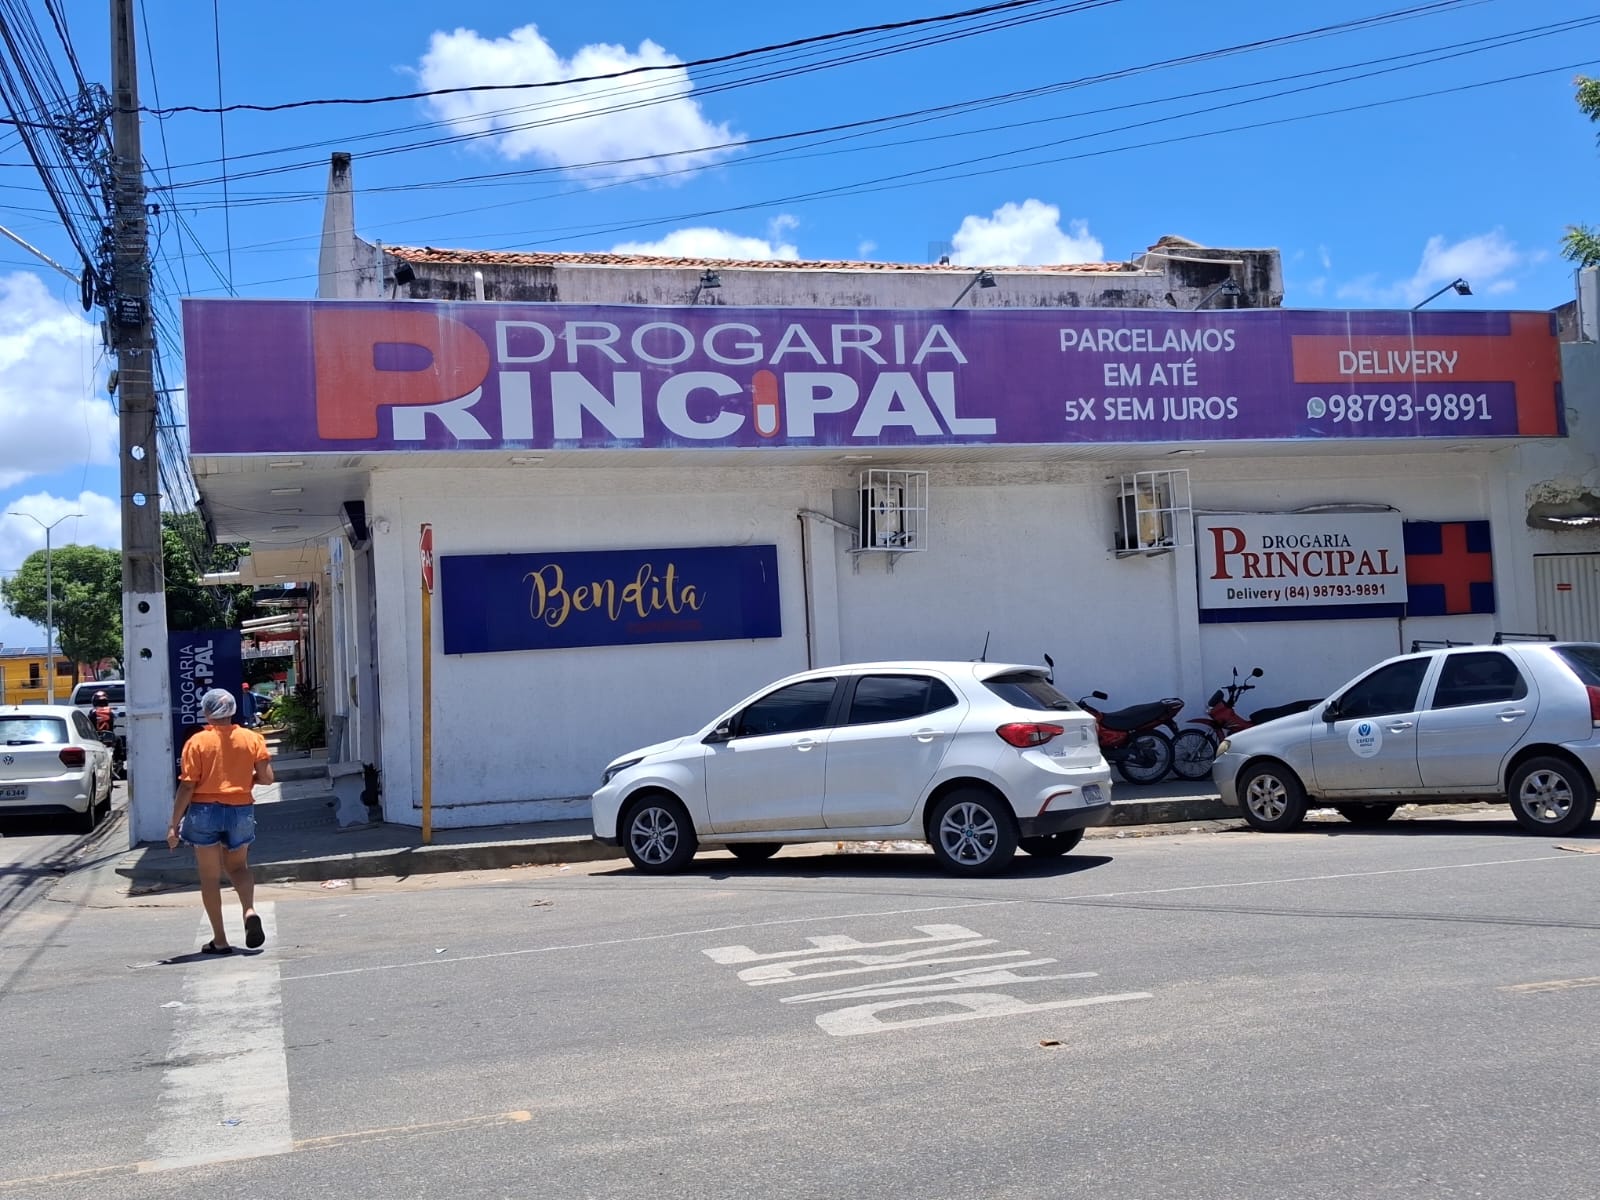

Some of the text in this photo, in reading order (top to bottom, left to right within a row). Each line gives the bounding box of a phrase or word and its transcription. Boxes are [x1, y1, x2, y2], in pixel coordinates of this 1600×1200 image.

[495, 320, 967, 366] DROGARIA
[1059, 328, 1236, 353] PARCELAMOS
[316, 309, 997, 440] PRINCIPAL
[1104, 358, 1198, 387] EM ATÉ
[1339, 350, 1458, 375] DELIVERY
[1065, 396, 1239, 422] 5X SEM JUROS
[1329, 393, 1493, 423] 98793-9891
[1207, 526, 1399, 580] PRINCIPAL
[1261, 533, 1352, 550] DROGARIA
[522, 562, 706, 628] Bendita
[1226, 583, 1386, 603] Delivery (84) 98793-9891
[180, 644, 196, 724] DROGARIA
